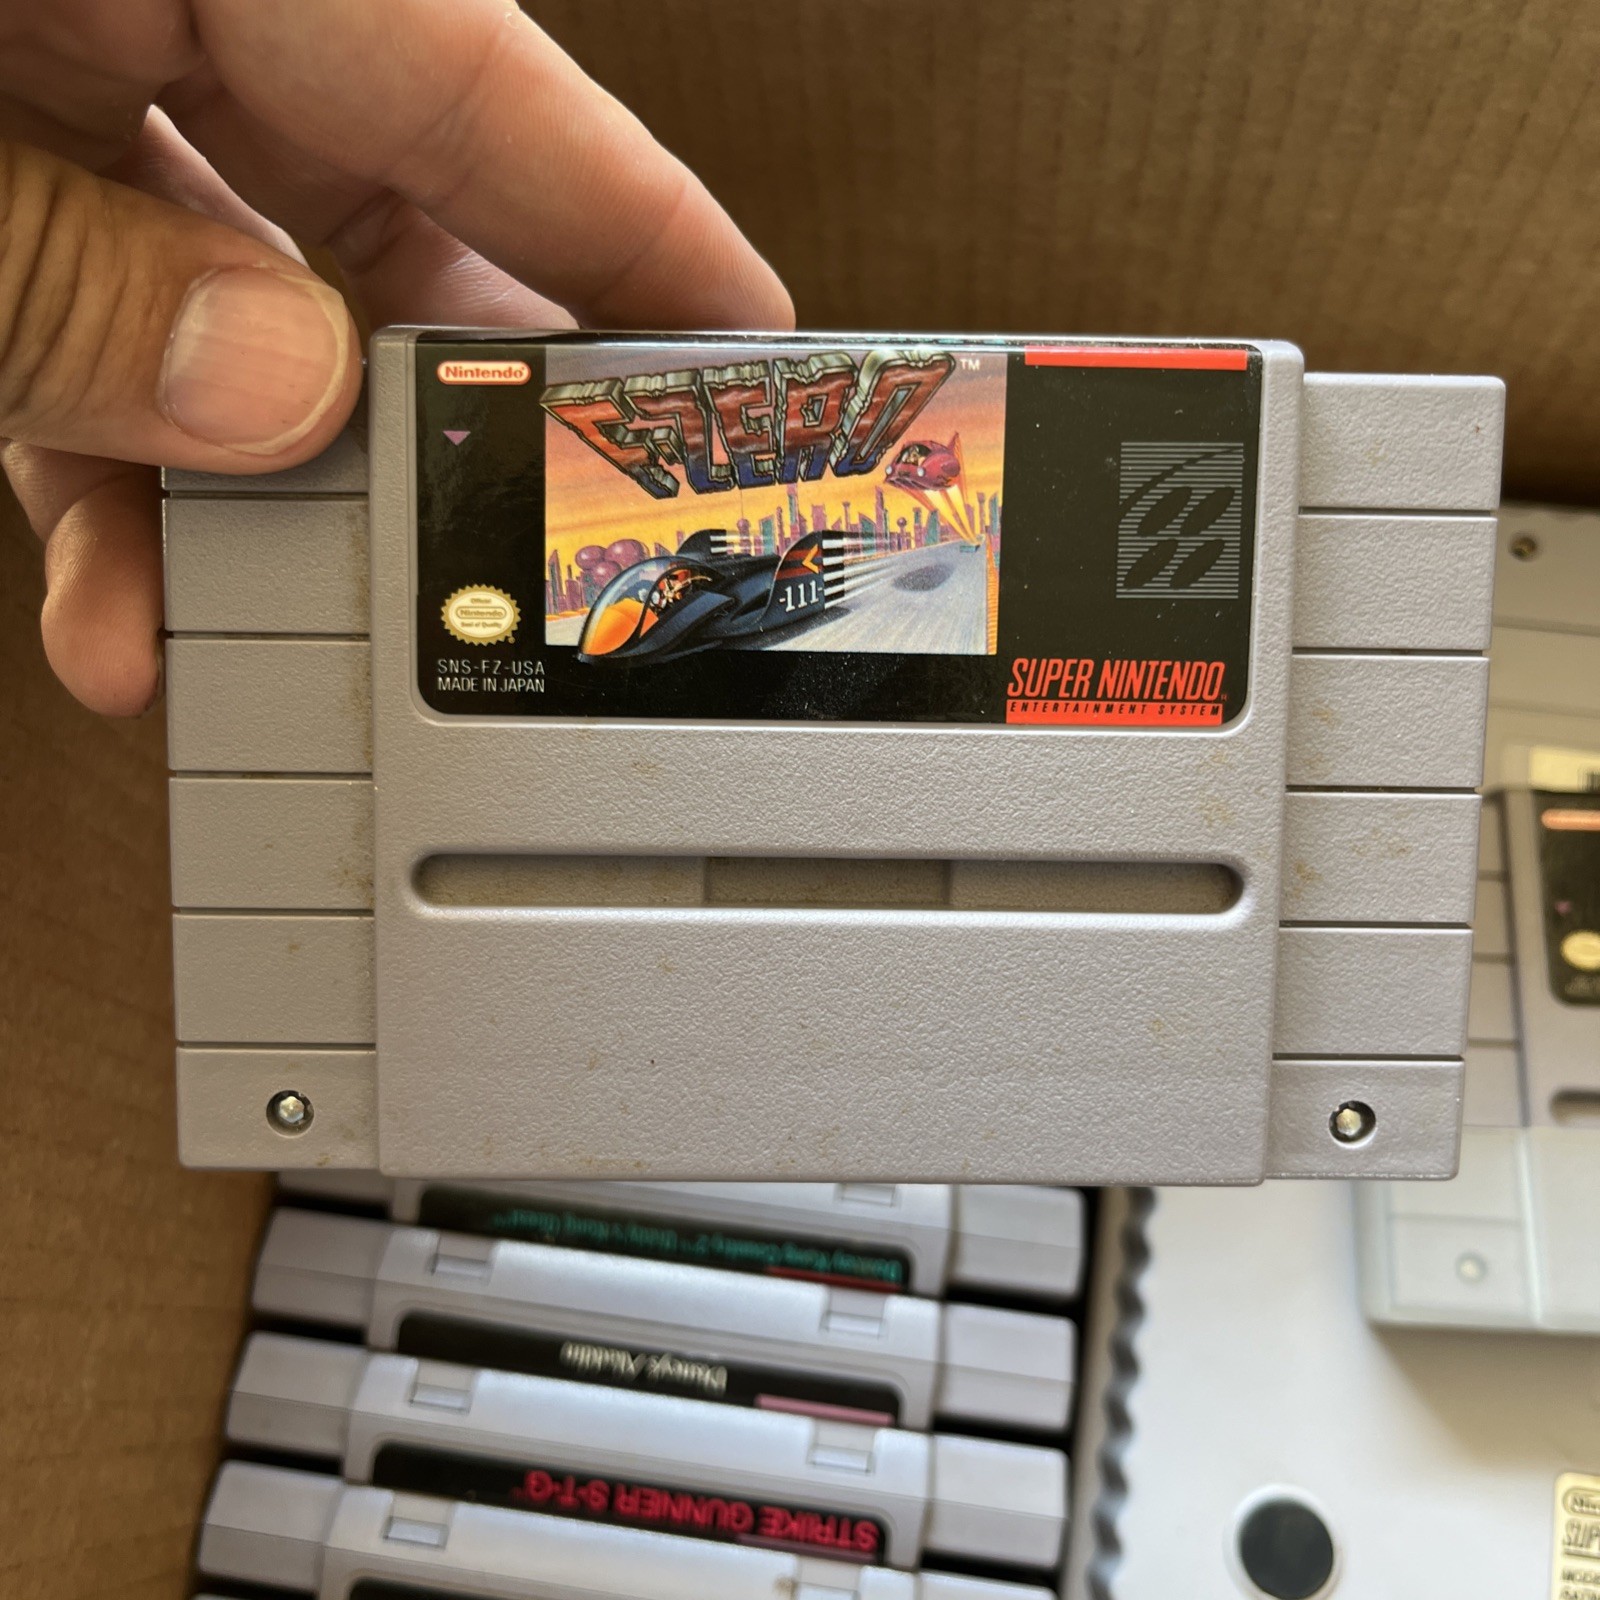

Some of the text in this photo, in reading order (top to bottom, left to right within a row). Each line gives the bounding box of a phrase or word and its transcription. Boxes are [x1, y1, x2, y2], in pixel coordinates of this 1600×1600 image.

[445, 365, 523, 379] Nintendo
[438, 676, 546, 693] MADE IN JAPAN
[1006, 657, 1226, 701] SUPER NINTENDO
[1009, 701, 1220, 717] ENTERTAINMENT SYSTEM
[612, 1483, 754, 1533] GUNNER
[757, 1504, 880, 1552] STRIKE
